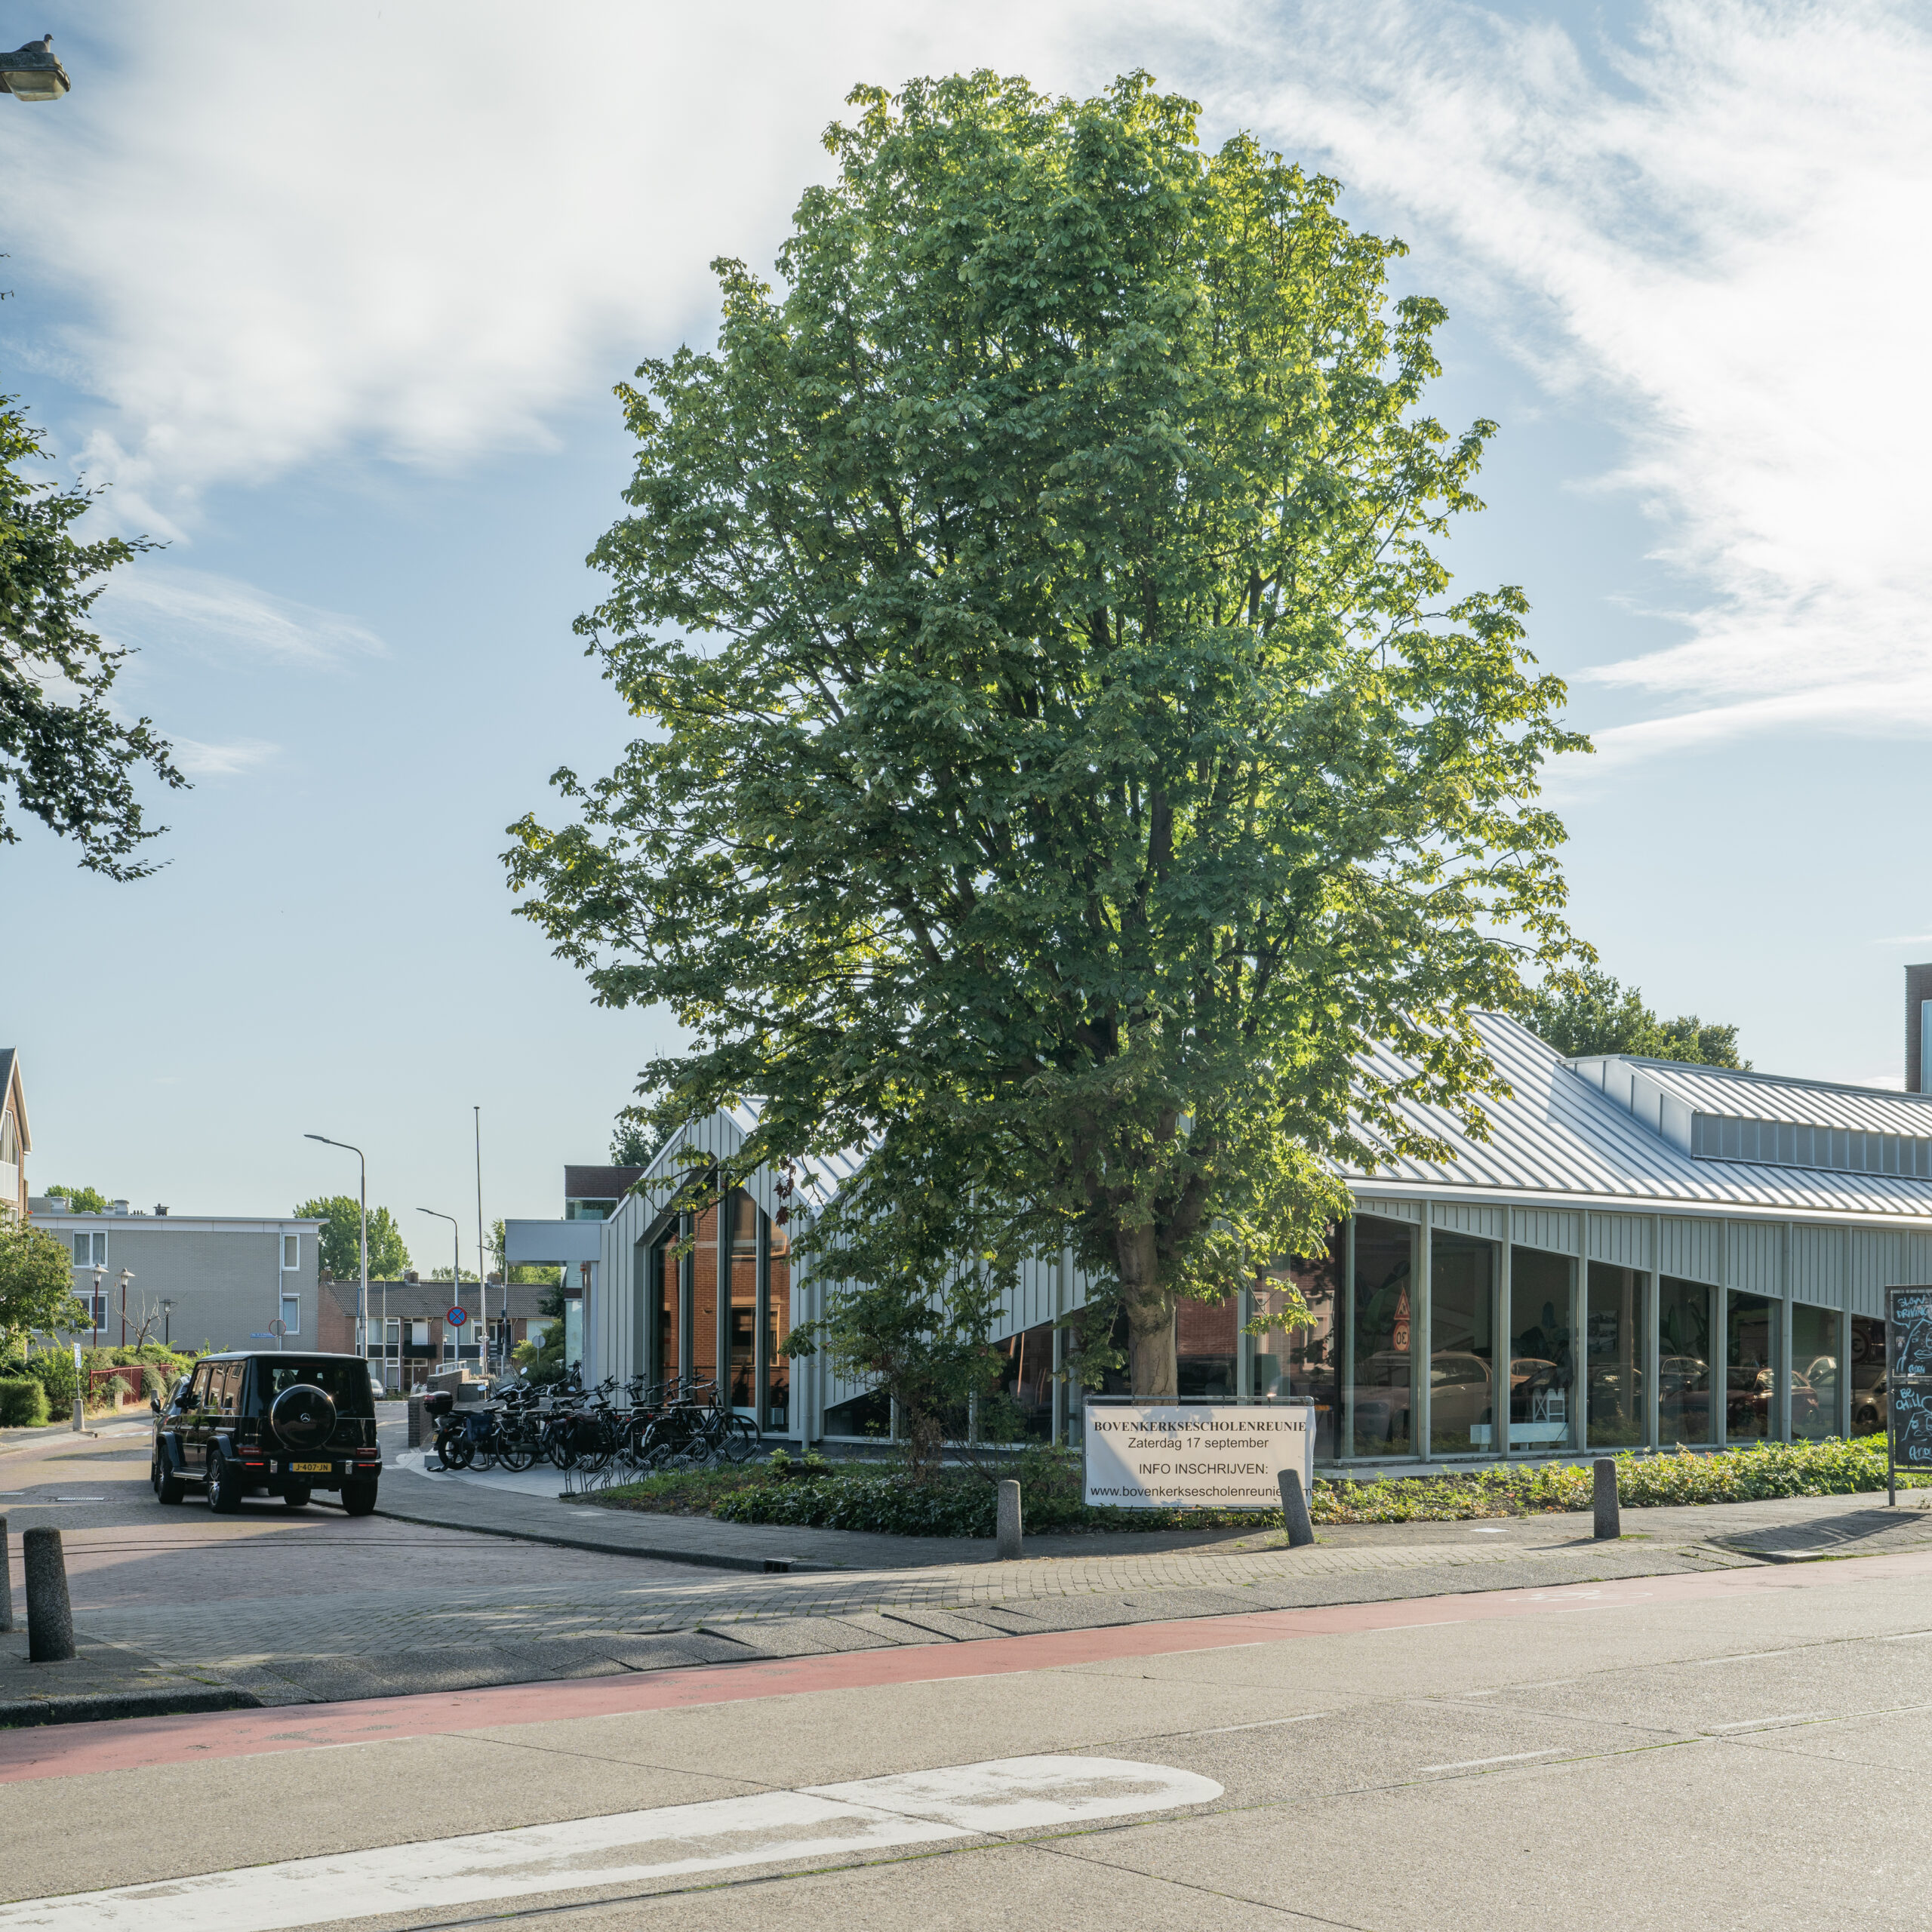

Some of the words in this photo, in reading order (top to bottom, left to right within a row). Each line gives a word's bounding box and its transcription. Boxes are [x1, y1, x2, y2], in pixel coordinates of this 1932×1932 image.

[1094, 1421, 1306, 1432] BOVENKERKSESCHOLENREUNIE
[1128, 1438, 1182, 1451] Zaterdag
[1187, 1438, 1201, 1448] 17
[1204, 1438, 1269, 1451] september
[1139, 1463, 1171, 1474] INFO
[1175, 1463, 1269, 1474] INSCHRIJVEN:
[1091, 1485, 1312, 1497] www.bovenkerksescholenreuniem
